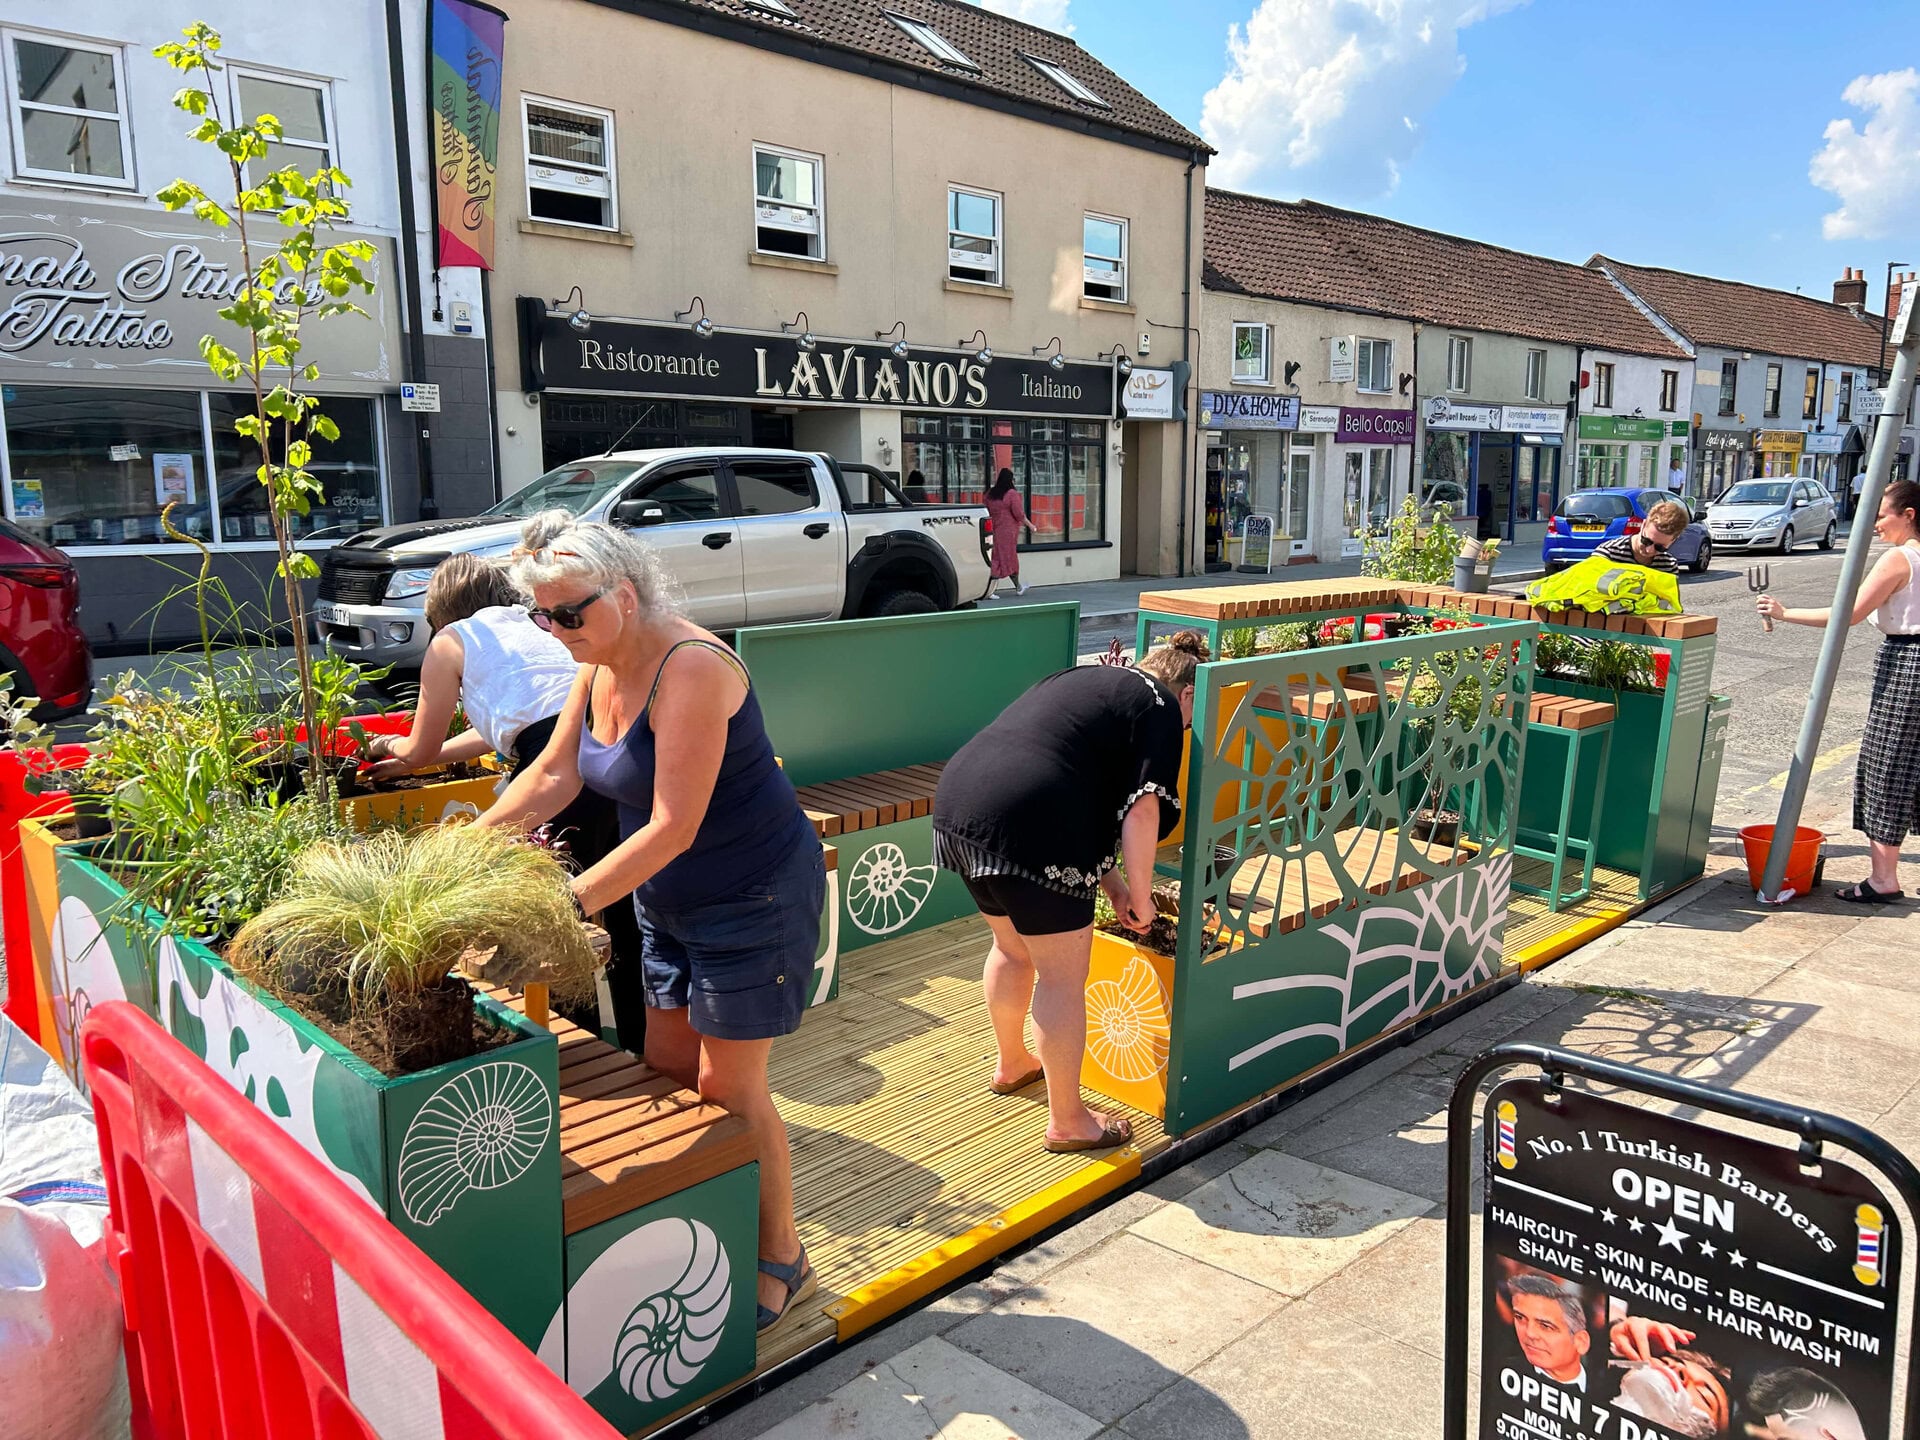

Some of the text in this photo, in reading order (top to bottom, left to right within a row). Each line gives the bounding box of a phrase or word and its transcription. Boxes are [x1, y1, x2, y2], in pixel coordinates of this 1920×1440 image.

[0, 289, 173, 349] Tattoo
[578, 339, 720, 377] Ristorante
[754, 346, 988, 407] LAVIANO'S
[1021, 373, 1082, 400] Italiano
[1309, 415, 1337, 425] Serendipity
[1345, 414, 1412, 437] Bello Capelli
[1530, 410, 1546, 422] hearing
[922, 515, 975, 529] RAPTOR
[1248, 527, 1270, 537] HOME
[1527, 1130, 1838, 1254] No. 1 Turkish Barbers
[1611, 1168, 1735, 1233] OPEN
[1492, 1206, 1578, 1249] HAIRCUT
[1594, 1242, 1644, 1273] SKIN
[1650, 1260, 1708, 1296] FADE
[1729, 1288, 1812, 1331] BEARD
[1819, 1318, 1880, 1355] TRIM
[1518, 1238, 1584, 1276] SHAVE
[1601, 1266, 1687, 1310] WAXING
[1707, 1305, 1763, 1340] HAIR
[1769, 1326, 1841, 1367] WASH
[1500, 1368, 1581, 1425] OPEN
[1591, 1405, 1610, 1435] 7
[1524, 1408, 1562, 1439] MON
